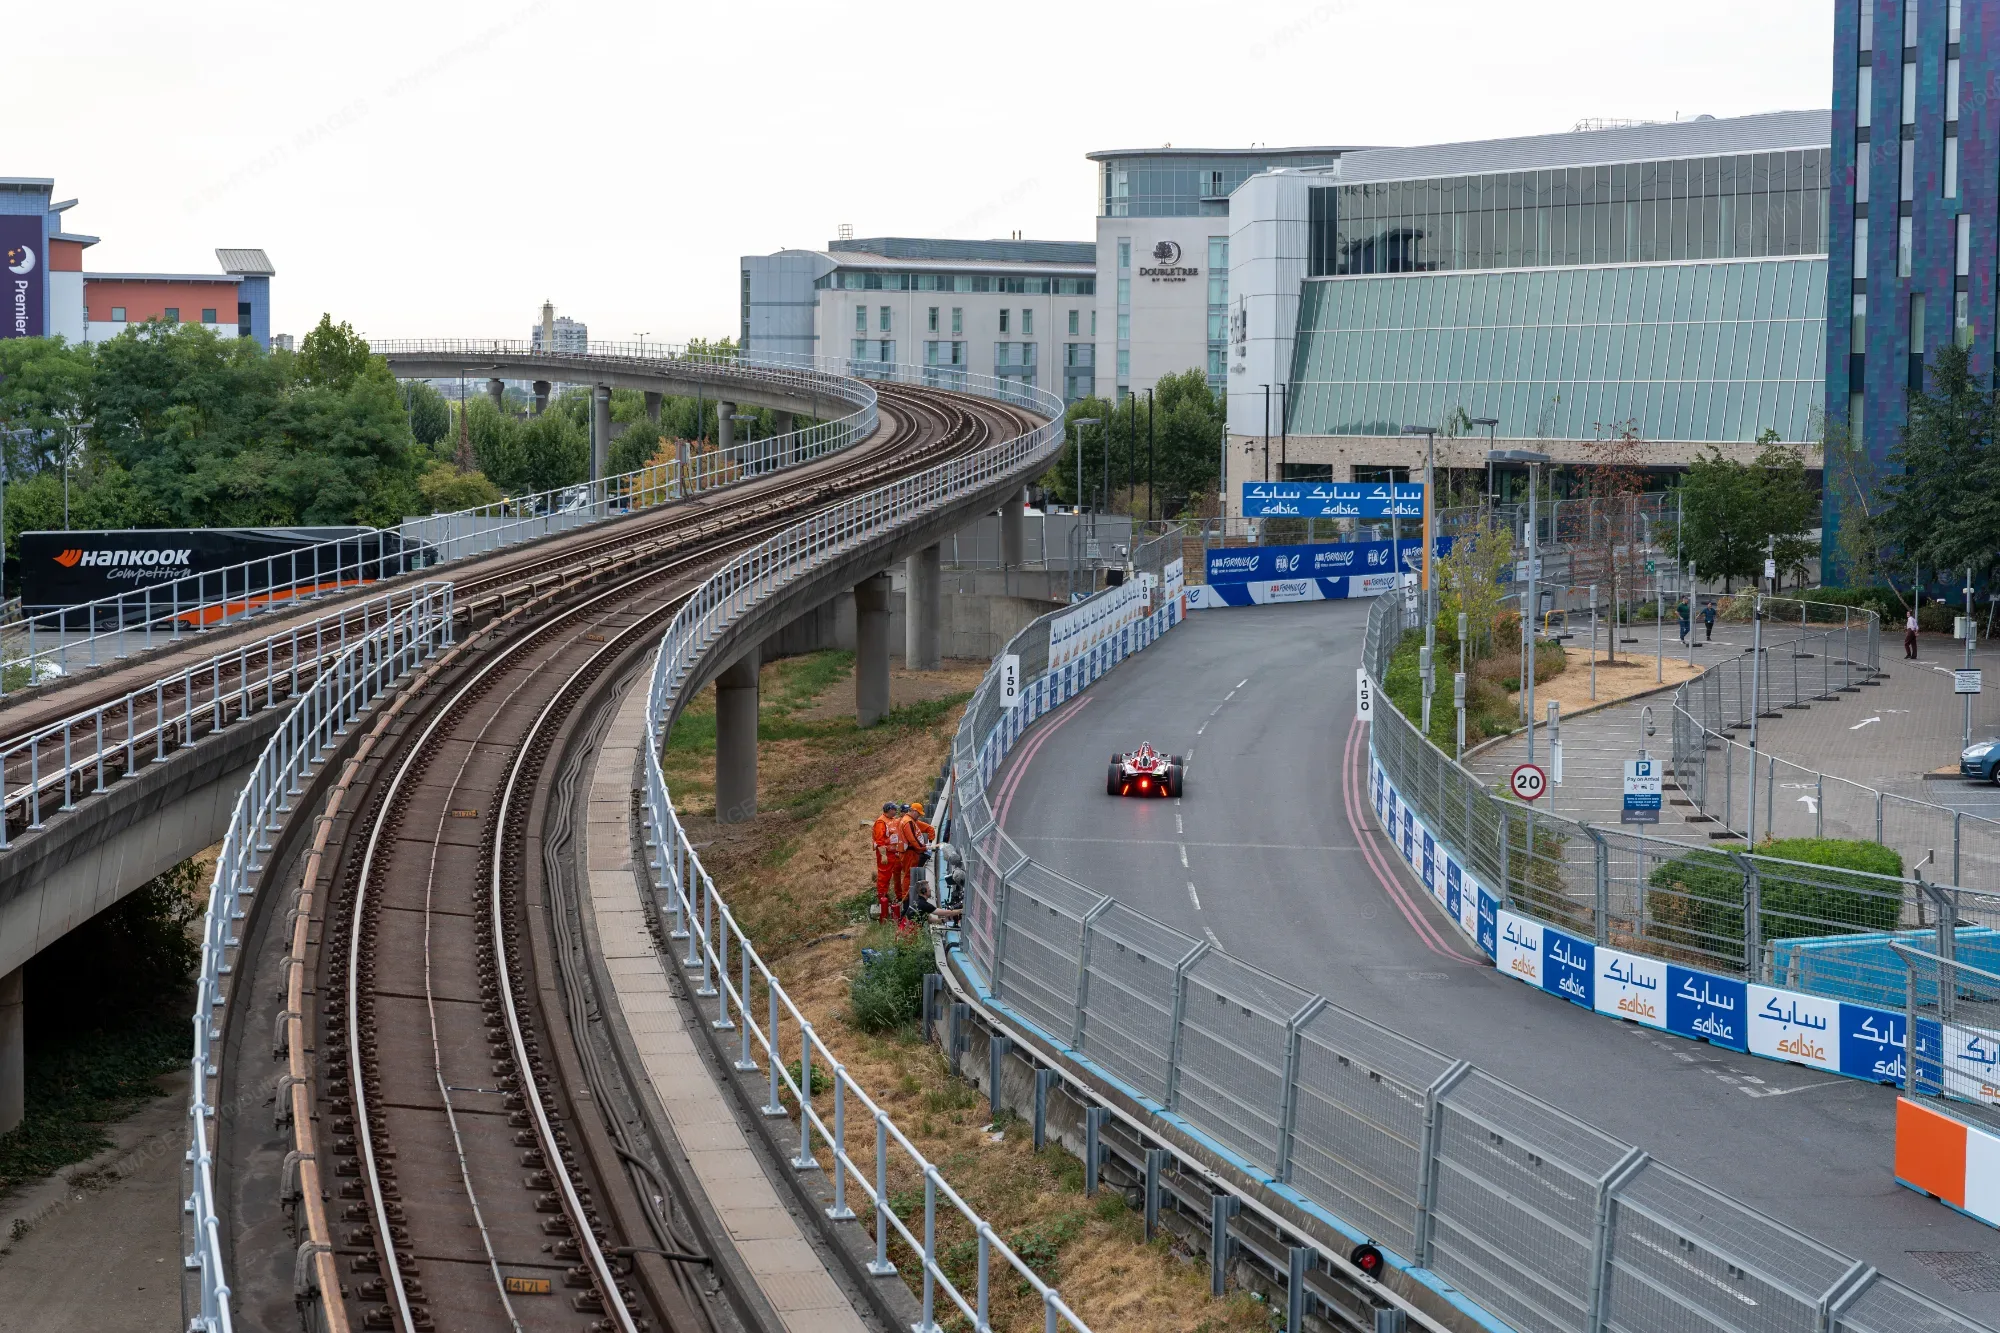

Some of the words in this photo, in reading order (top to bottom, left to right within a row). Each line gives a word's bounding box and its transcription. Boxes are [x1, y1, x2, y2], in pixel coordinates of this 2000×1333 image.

[15, 280, 29, 335] Premier
[1006, 665, 1015, 697] 150
[1361, 679, 1369, 711] 150
[1517, 774, 1540, 789] 20
